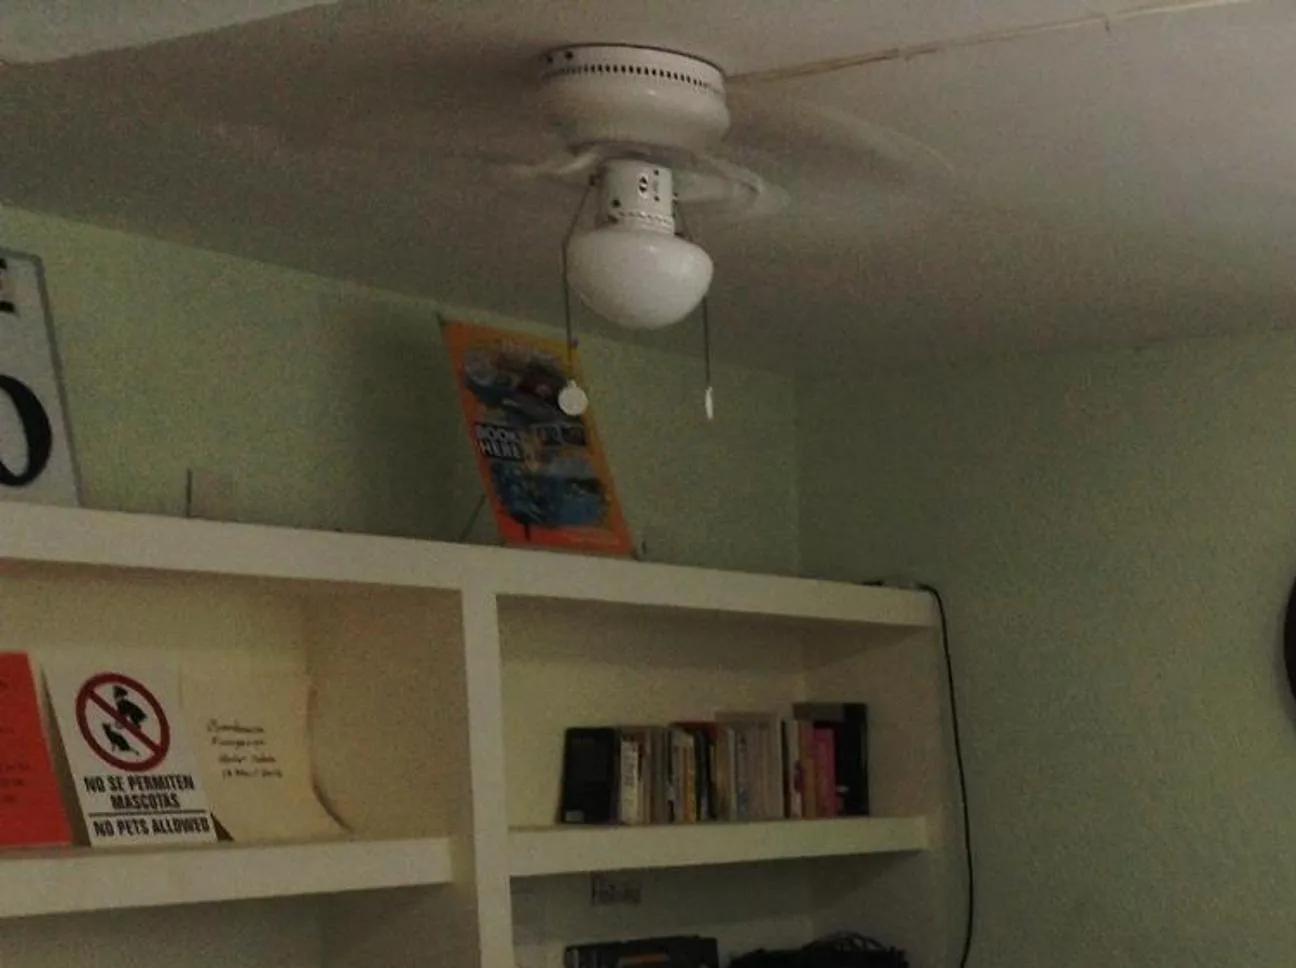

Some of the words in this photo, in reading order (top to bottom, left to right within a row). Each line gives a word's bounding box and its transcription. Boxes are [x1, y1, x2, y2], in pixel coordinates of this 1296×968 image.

[84, 775, 106, 793] NO
[107, 775, 125, 792] SE
[127, 774, 195, 791] PERMITEN
[110, 792, 180, 810] MASCOTAS
[93, 819, 115, 837] NO
[116, 818, 150, 836] PETS
[151, 816, 210, 834] ALLOWED
